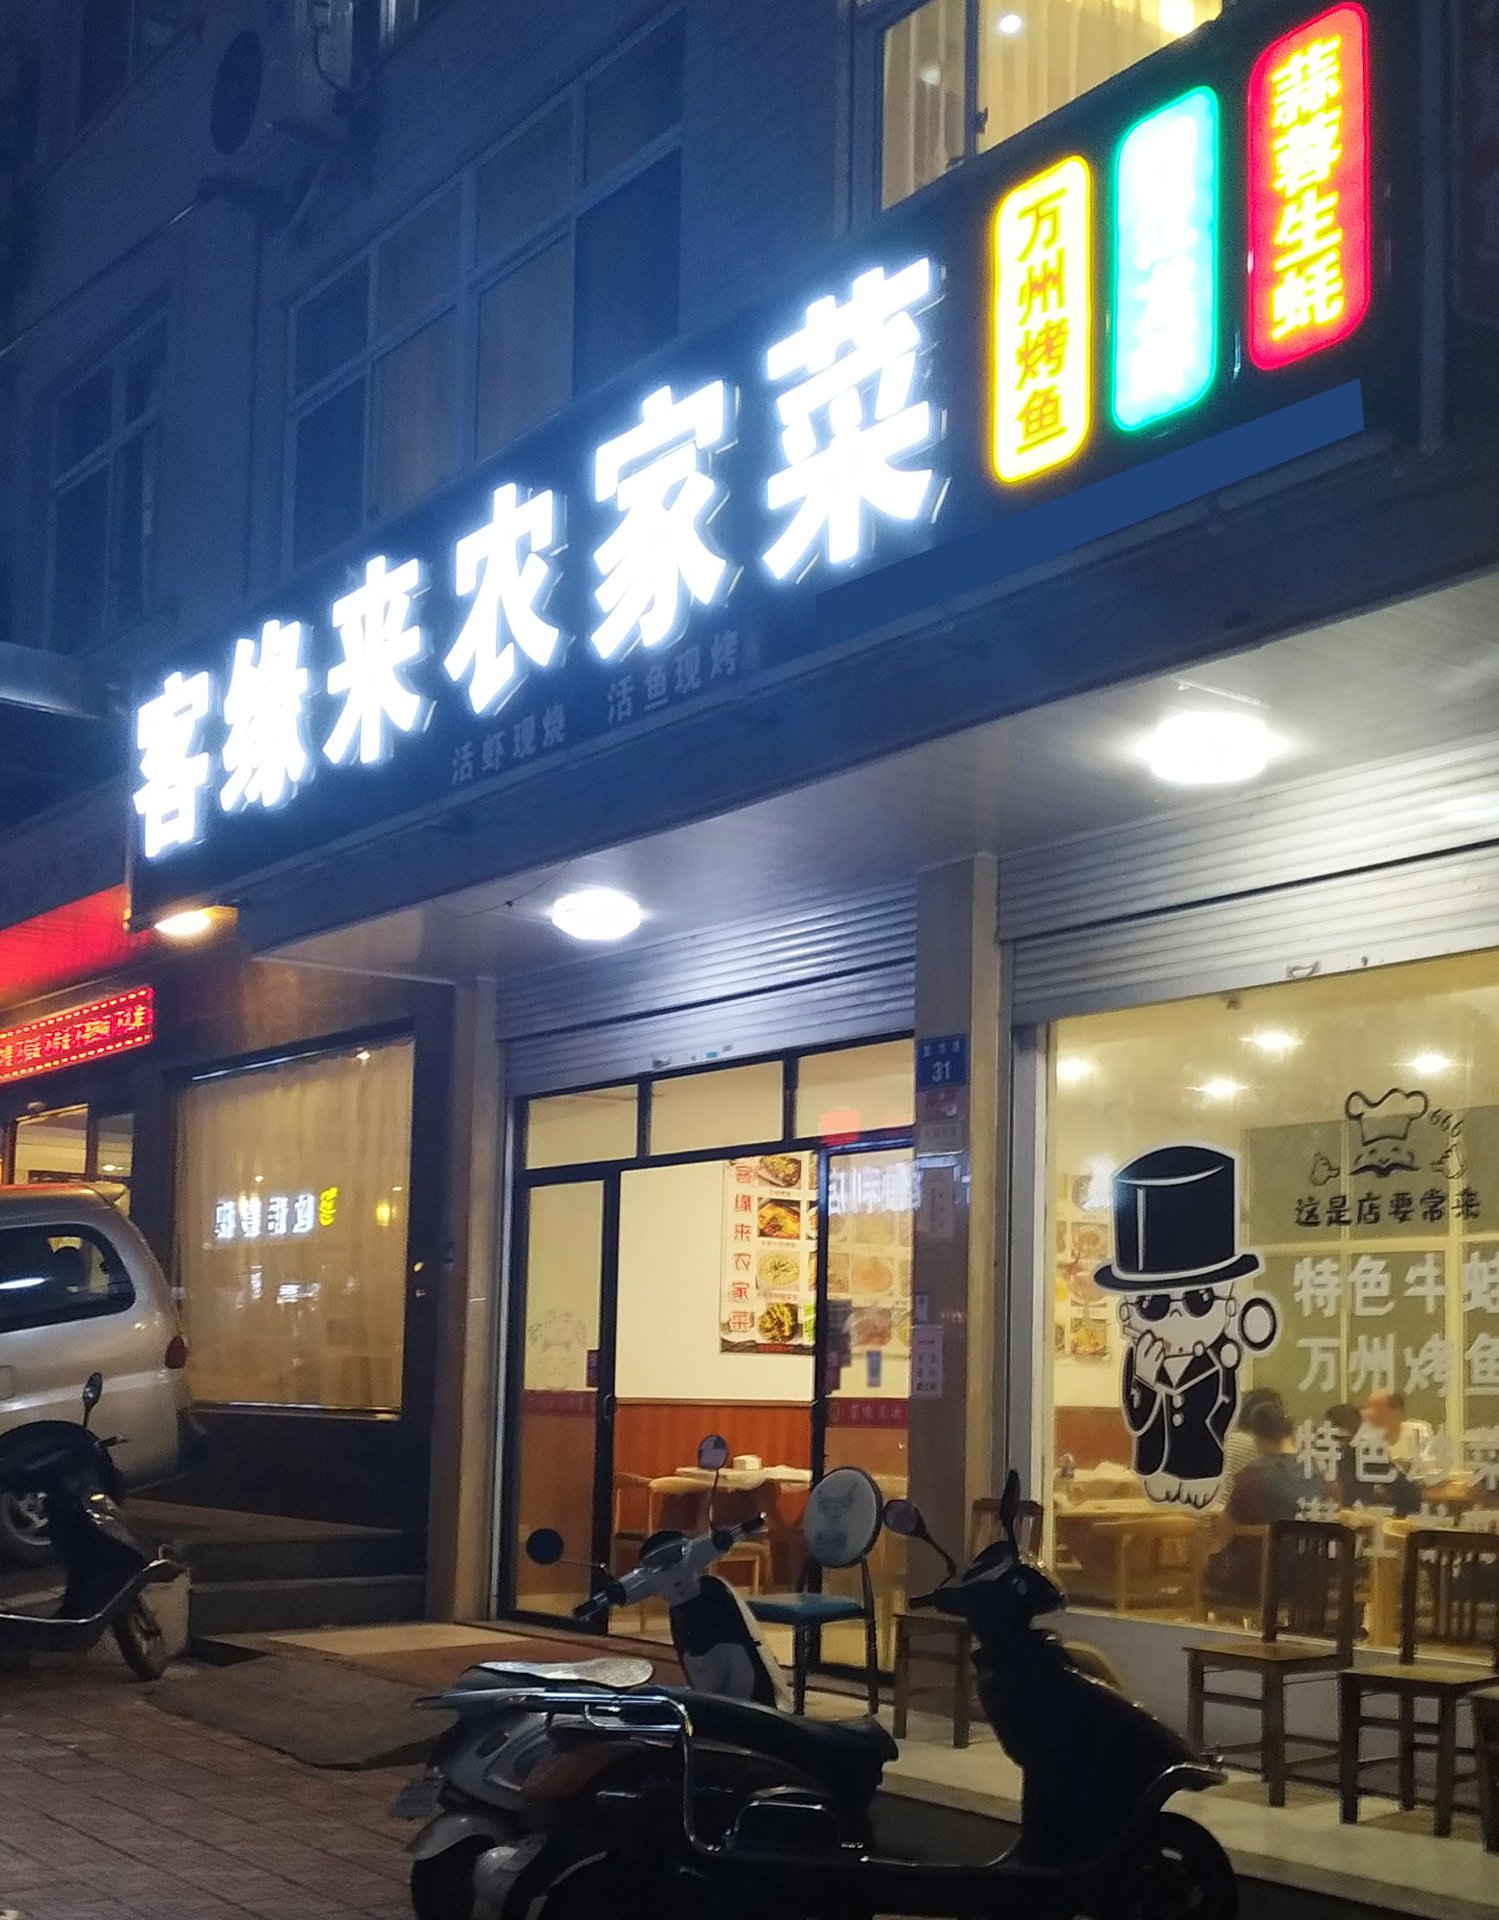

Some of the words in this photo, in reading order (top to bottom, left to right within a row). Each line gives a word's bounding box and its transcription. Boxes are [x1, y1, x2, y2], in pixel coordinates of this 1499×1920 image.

[1270, 34, 1344, 342] 蒜蓉生蚝
[1016, 187, 1068, 455] 万州烤鱼
[133, 257, 932, 857] 客缘来农家菜
[606, 629, 740, 724] 活鱼现烤
[932, 1060, 952, 1082] 31
[1296, 1332, 1499, 1397] 万州烤鱼
